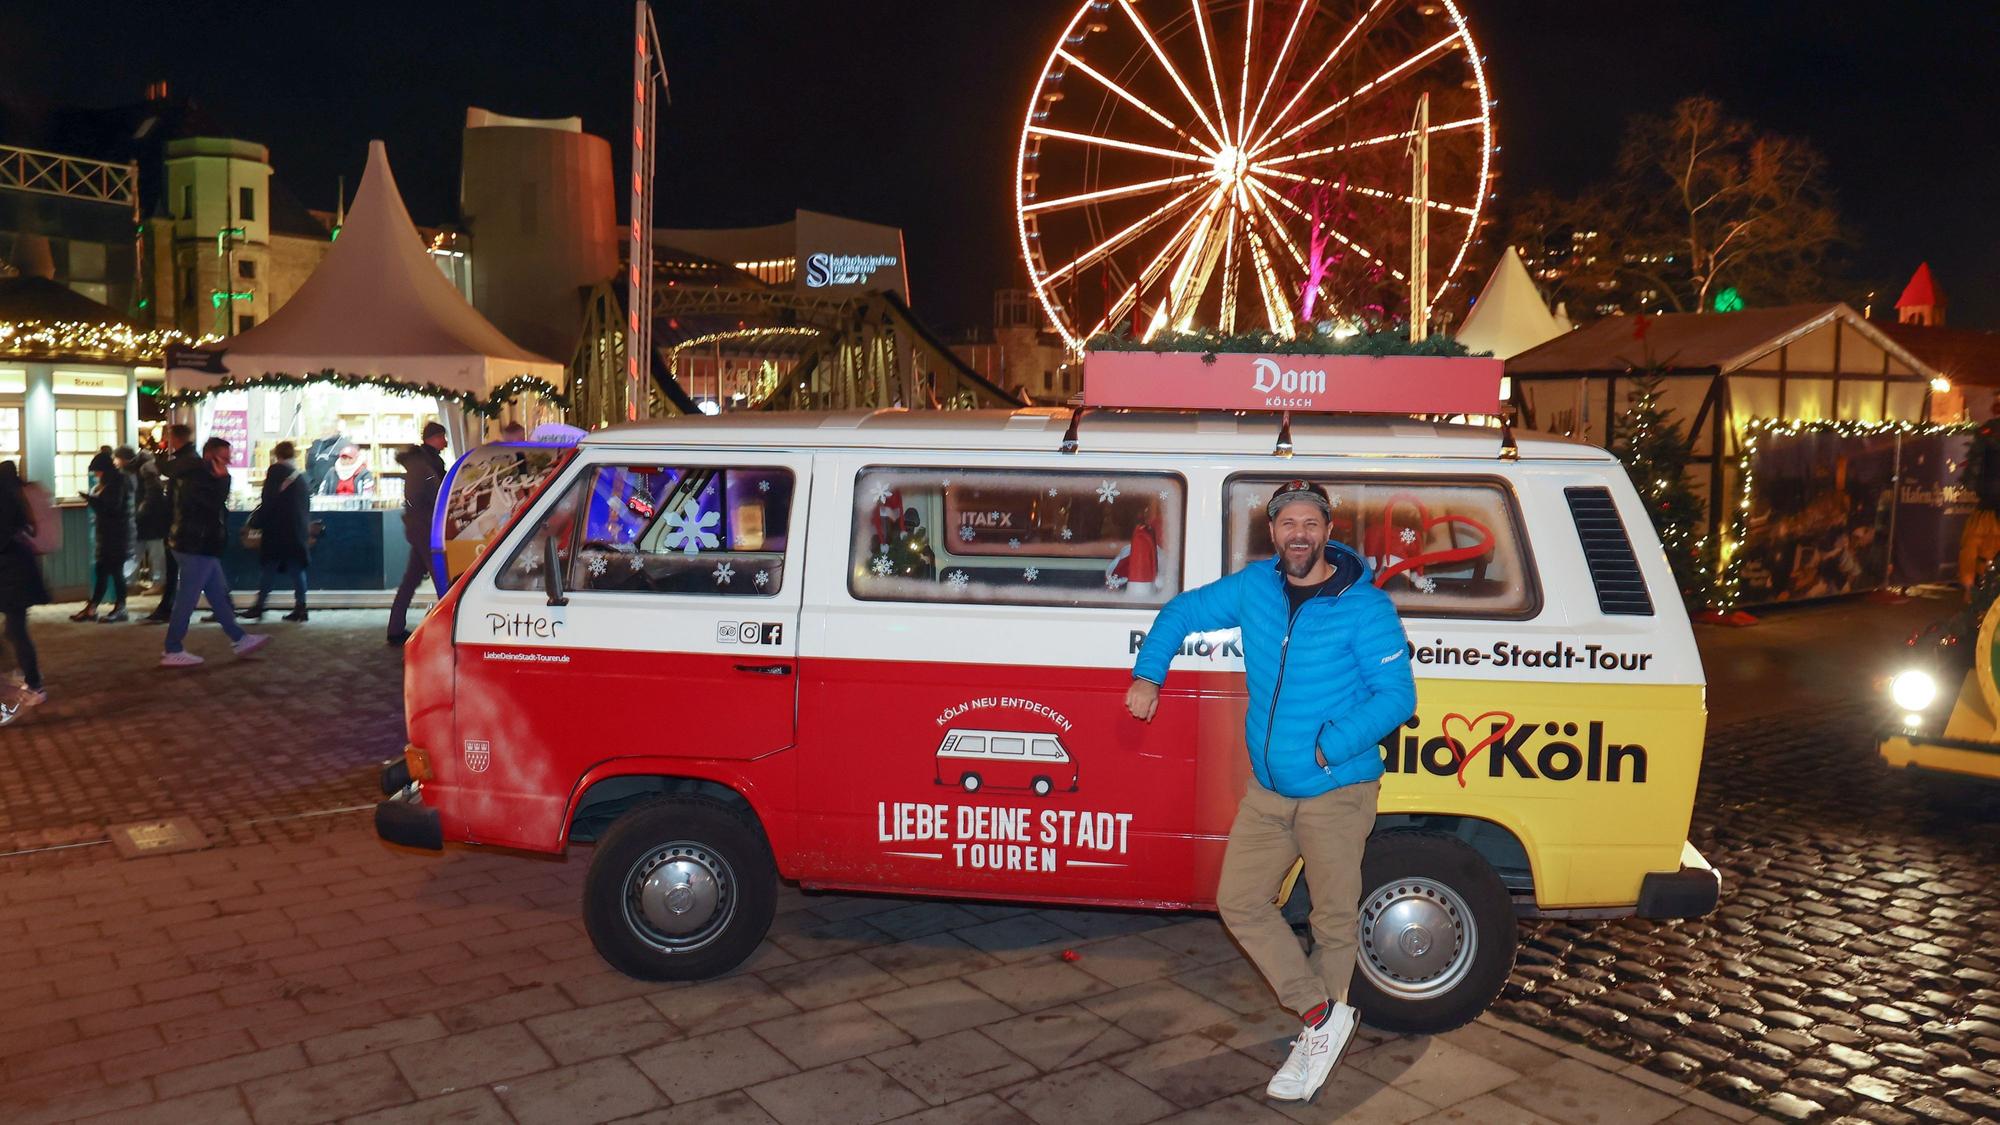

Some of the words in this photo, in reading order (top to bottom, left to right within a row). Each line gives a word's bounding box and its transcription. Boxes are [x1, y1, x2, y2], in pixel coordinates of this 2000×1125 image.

[1252, 357, 1327, 394] Dom
[1265, 396, 1313, 408] KÖLSCH
[959, 511, 997, 526] ITAL
[1000, 511, 1013, 527] X
[486, 612, 564, 638] Pitter
[483, 651, 571, 663] LiebeDeineStadt-Touren.de
[936, 702, 969, 727] KÖLN
[971, 696, 998, 710] NEU
[1001, 696, 1073, 733] ENTDECKEN
[1488, 720, 1649, 783] Köln
[878, 801, 950, 843] LIEBE
[956, 804, 1032, 843] DEINE
[1040, 809, 1134, 855] STADT
[952, 843, 1057, 873] TOUREN
